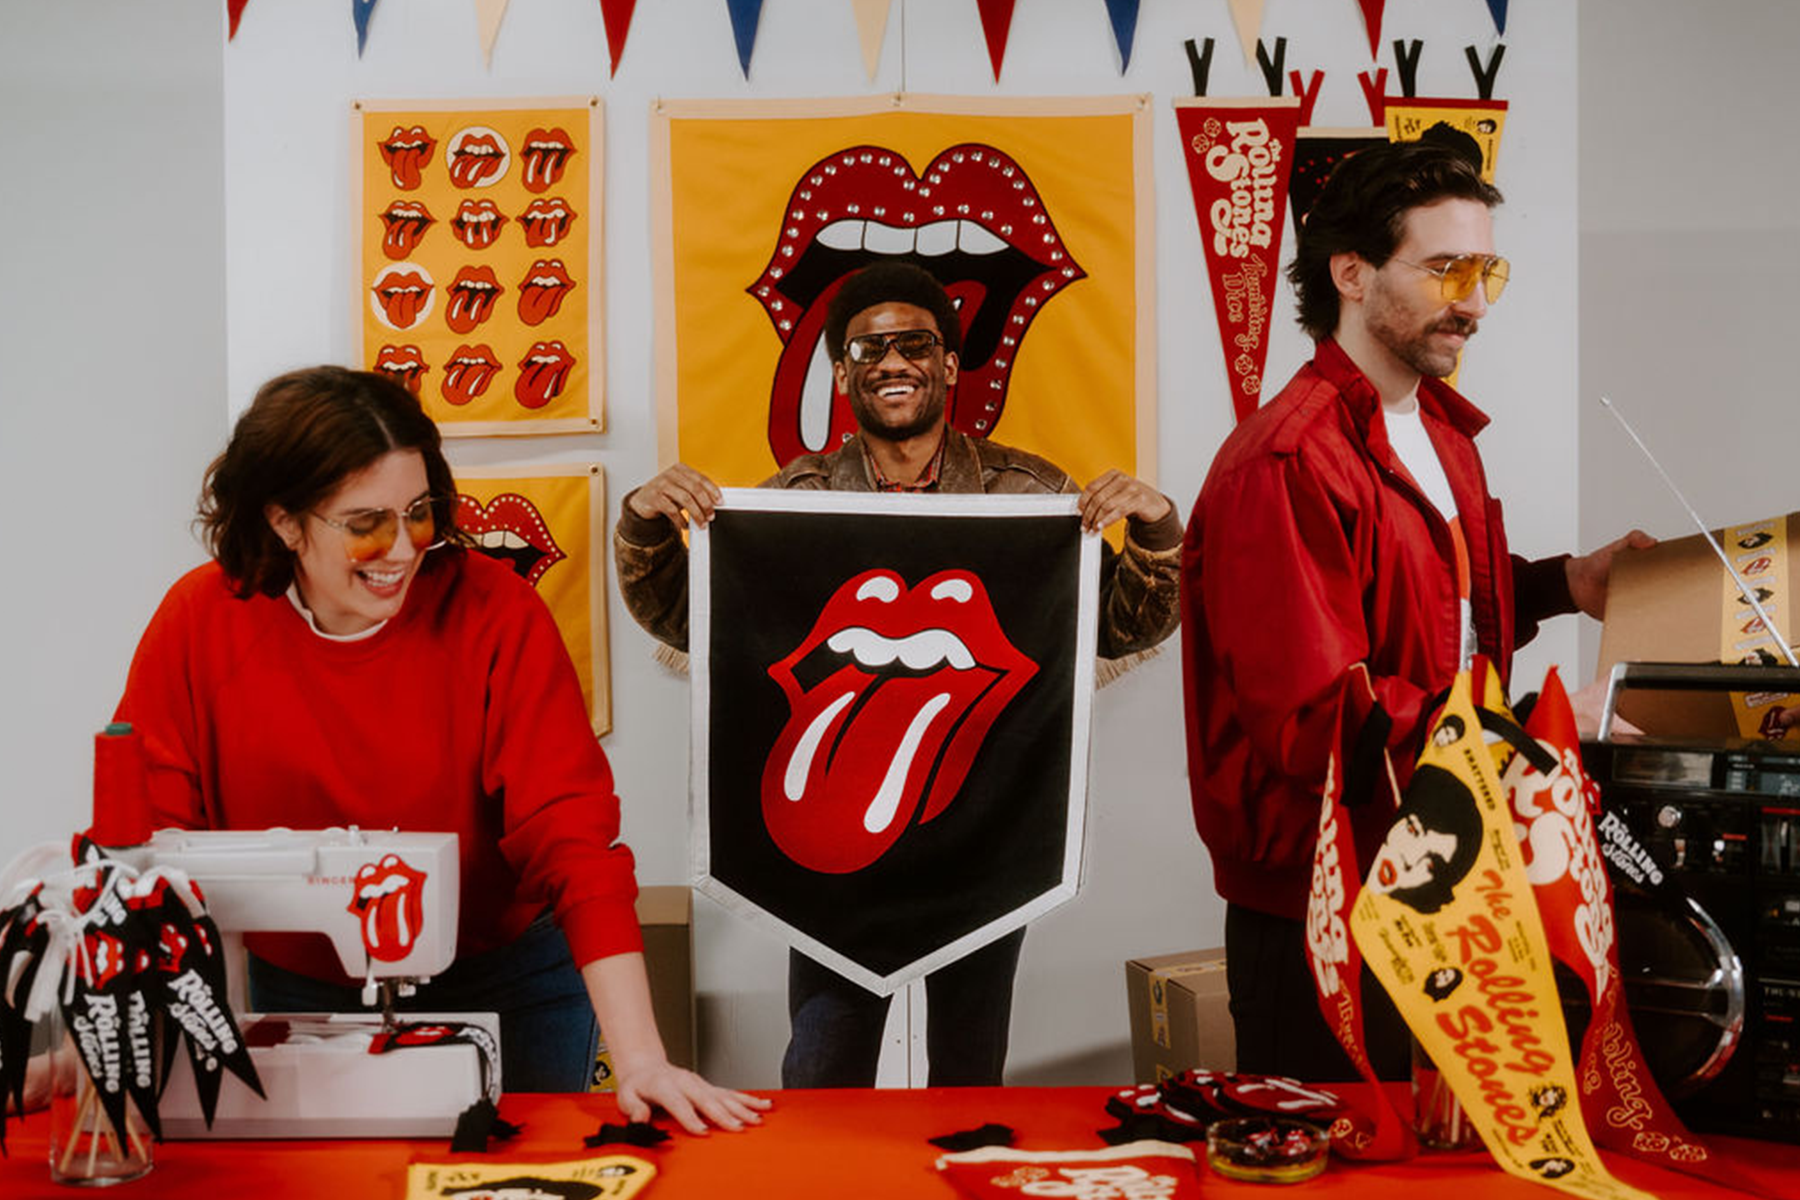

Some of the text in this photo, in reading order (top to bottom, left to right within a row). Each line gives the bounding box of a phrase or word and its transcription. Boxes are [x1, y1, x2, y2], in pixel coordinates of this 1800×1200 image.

[1205, 144, 1252, 258] Stones
[1225, 117, 1278, 250] Rolling
[1222, 271, 1246, 323] Dice
[1474, 868, 1514, 922] The
[1444, 914, 1556, 1077] Rolling
[1435, 1005, 1541, 1147] Stones
